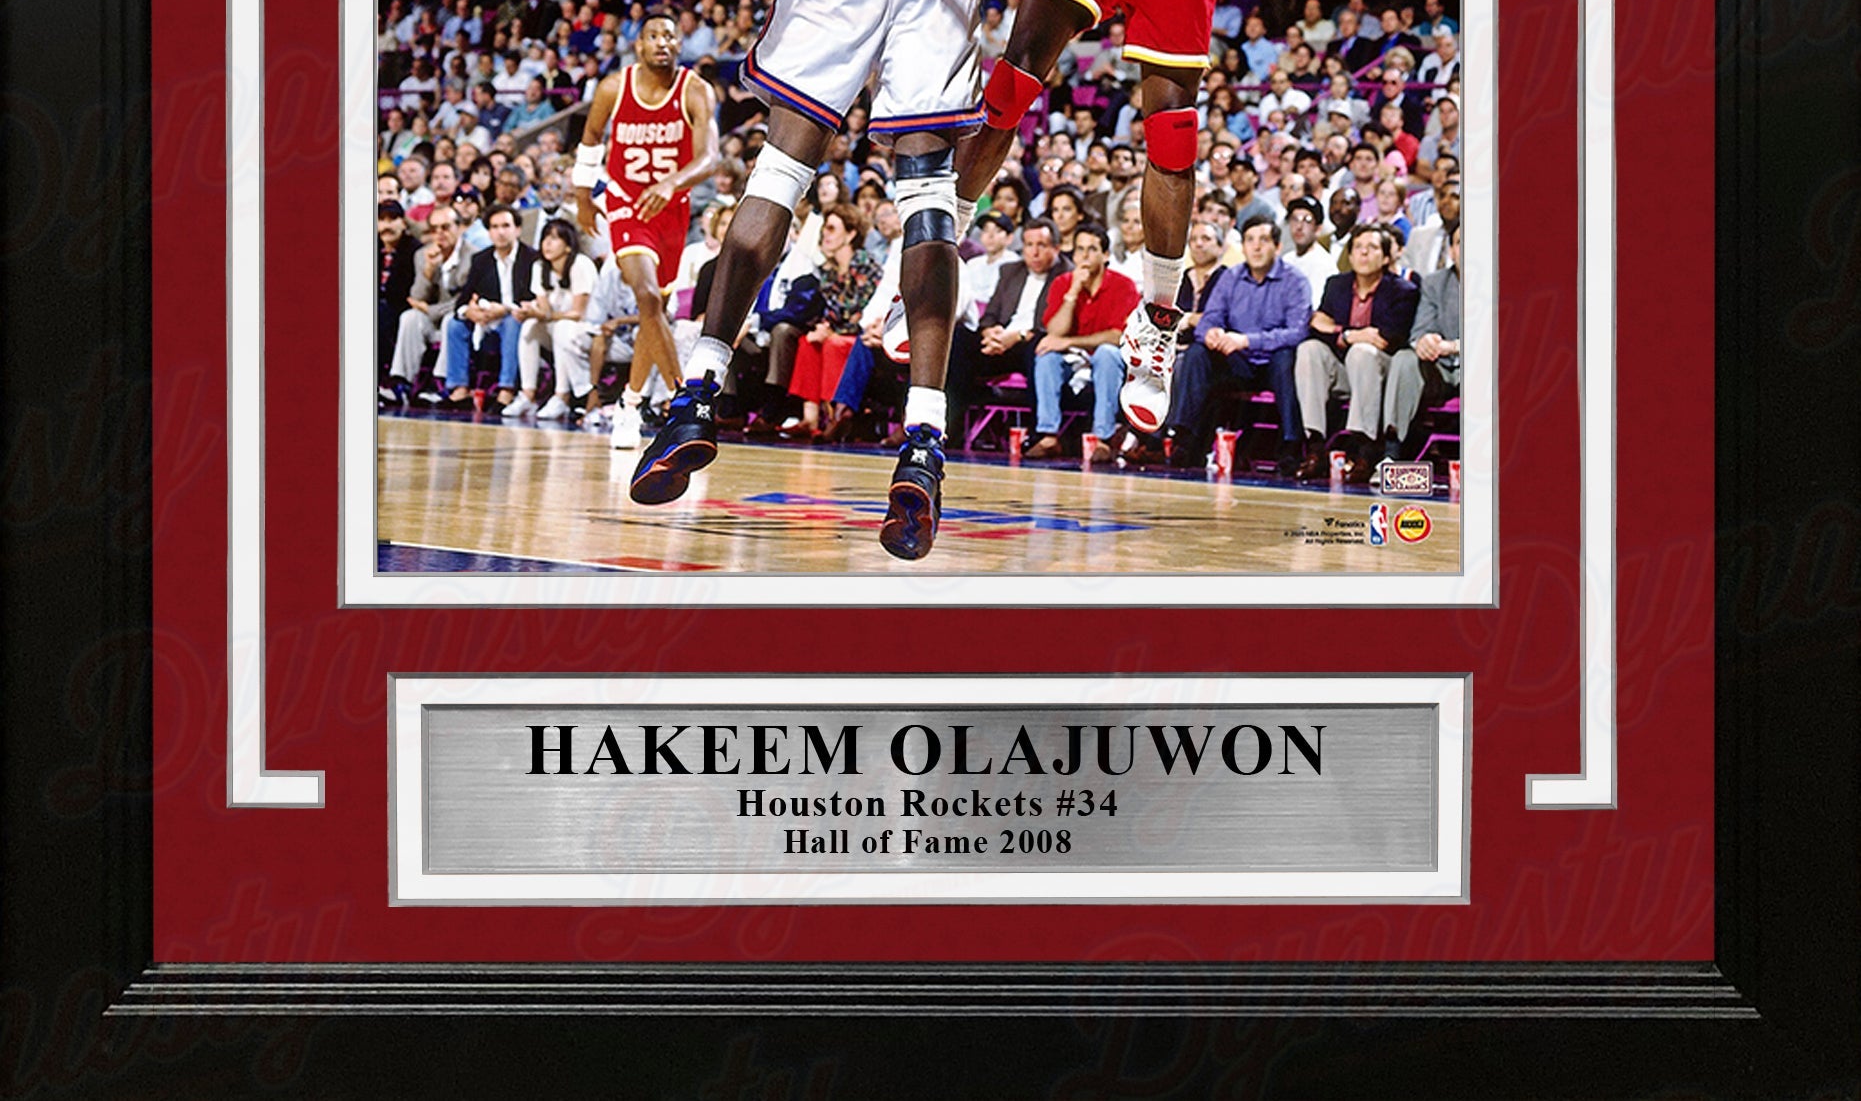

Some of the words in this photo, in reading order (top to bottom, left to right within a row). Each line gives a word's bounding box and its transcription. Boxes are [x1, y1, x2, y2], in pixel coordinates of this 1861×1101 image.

[623, 147, 679, 184] 25
[526, 724, 864, 775] HAKEEM
[890, 724, 1328, 776] OLAJUWON
[736, 789, 886, 817] Houston
[900, 789, 1043, 817] Rockets
[1056, 789, 1118, 817] #34
[783, 829, 850, 854] Hall
[861, 829, 894, 854] of
[902, 829, 988, 854] Fame
[999, 829, 1072, 854] 2008
